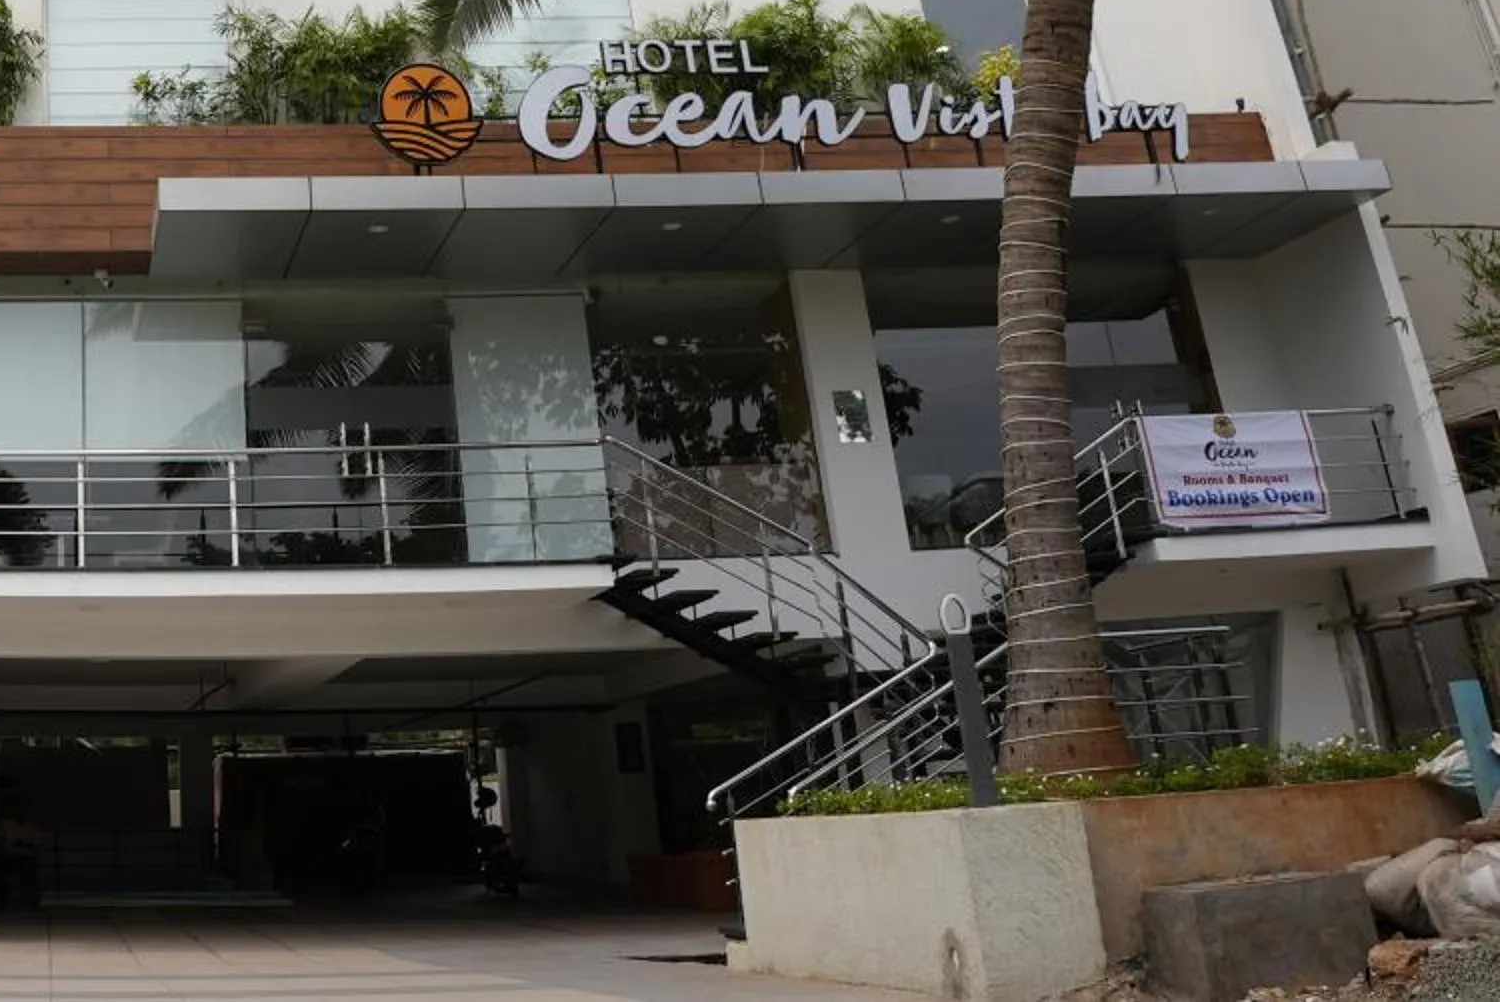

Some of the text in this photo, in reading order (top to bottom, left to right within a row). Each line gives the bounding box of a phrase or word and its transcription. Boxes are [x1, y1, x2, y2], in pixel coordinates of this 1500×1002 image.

[601, 39, 769, 74] HOTEL
[518, 64, 1190, 162] Ocean Vist bay
[1204, 440, 1259, 462] Ocean
[1182, 473, 1224, 486] Rooms
[1167, 487, 1315, 508] Bookings Open
